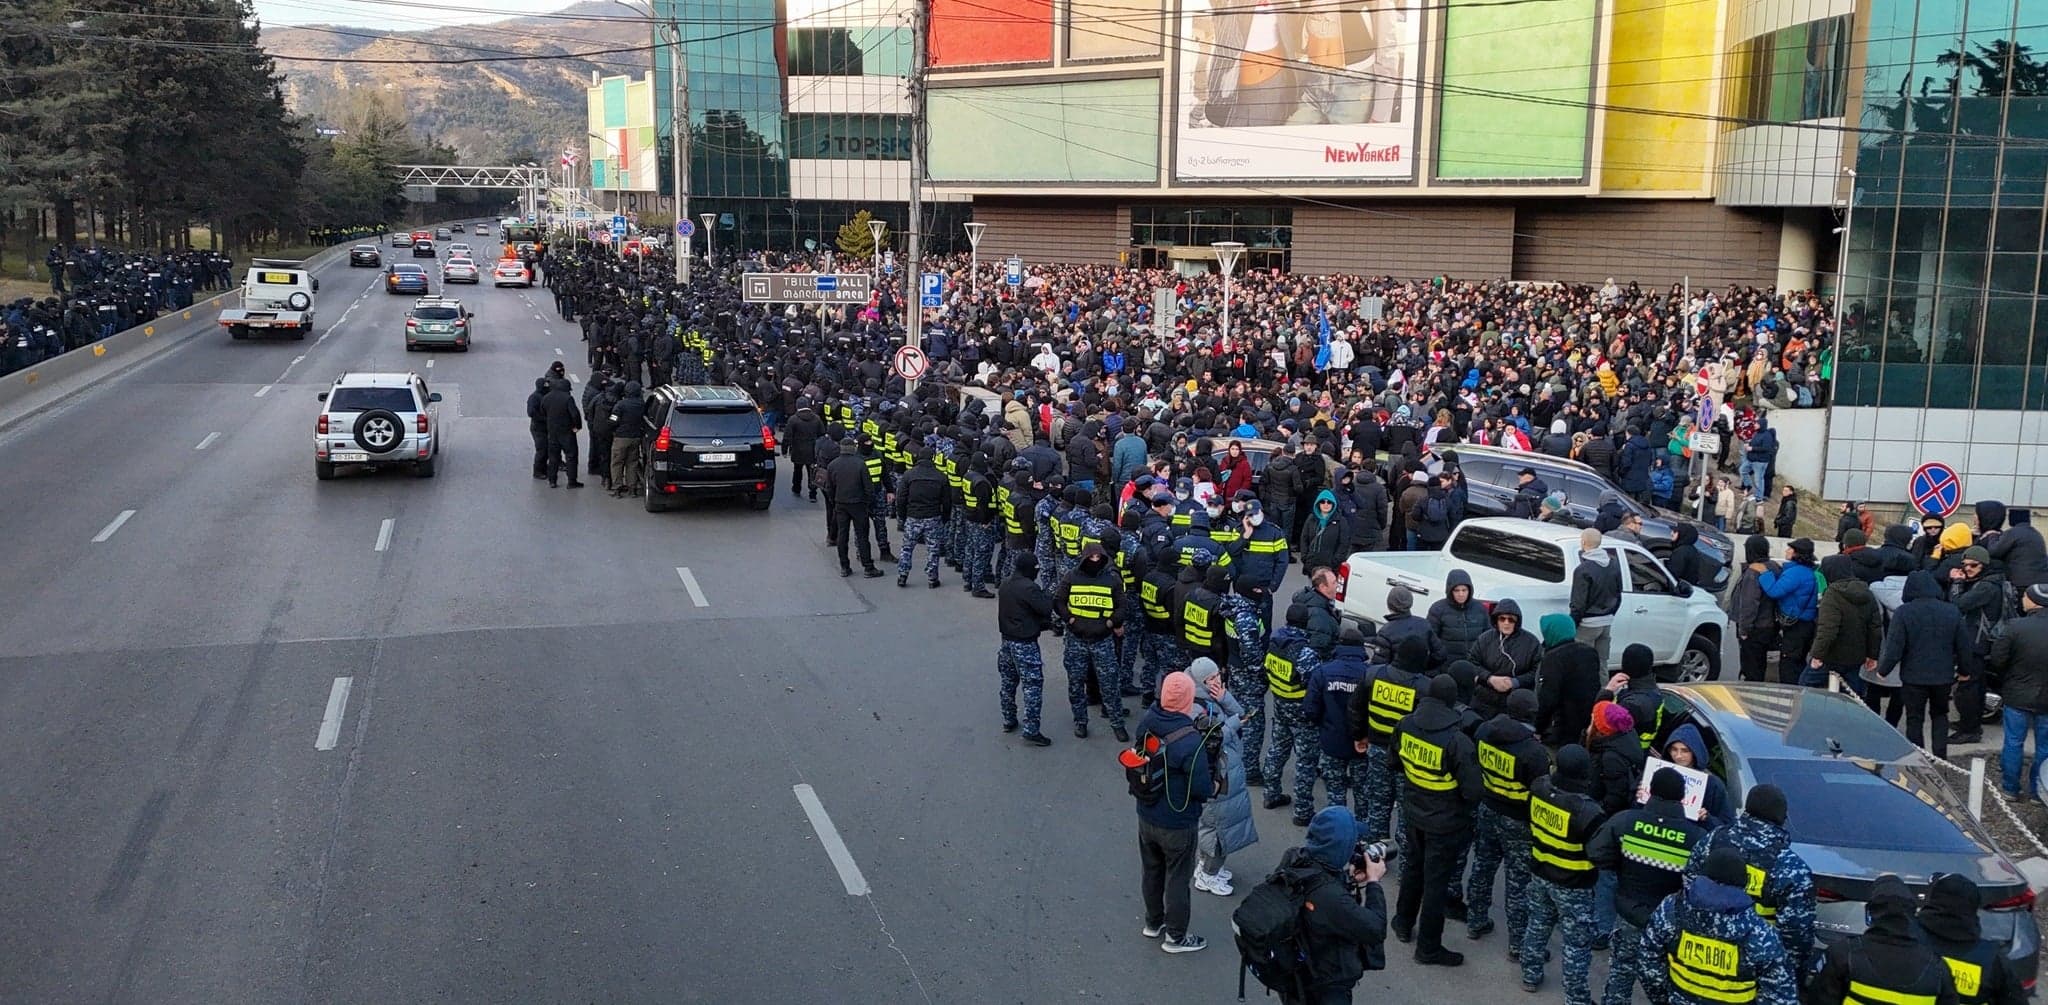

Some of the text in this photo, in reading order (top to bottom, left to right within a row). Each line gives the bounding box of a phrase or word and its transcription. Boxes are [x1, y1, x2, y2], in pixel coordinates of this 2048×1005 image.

[834, 137, 912, 152] TOPSPO
[783, 277, 864, 287] TBILIS ALL
[924, 275, 939, 294] P
[1074, 596, 1108, 607] POLICE
[1375, 684, 1412, 707] POLICE
[1634, 820, 1687, 844] POLICE
